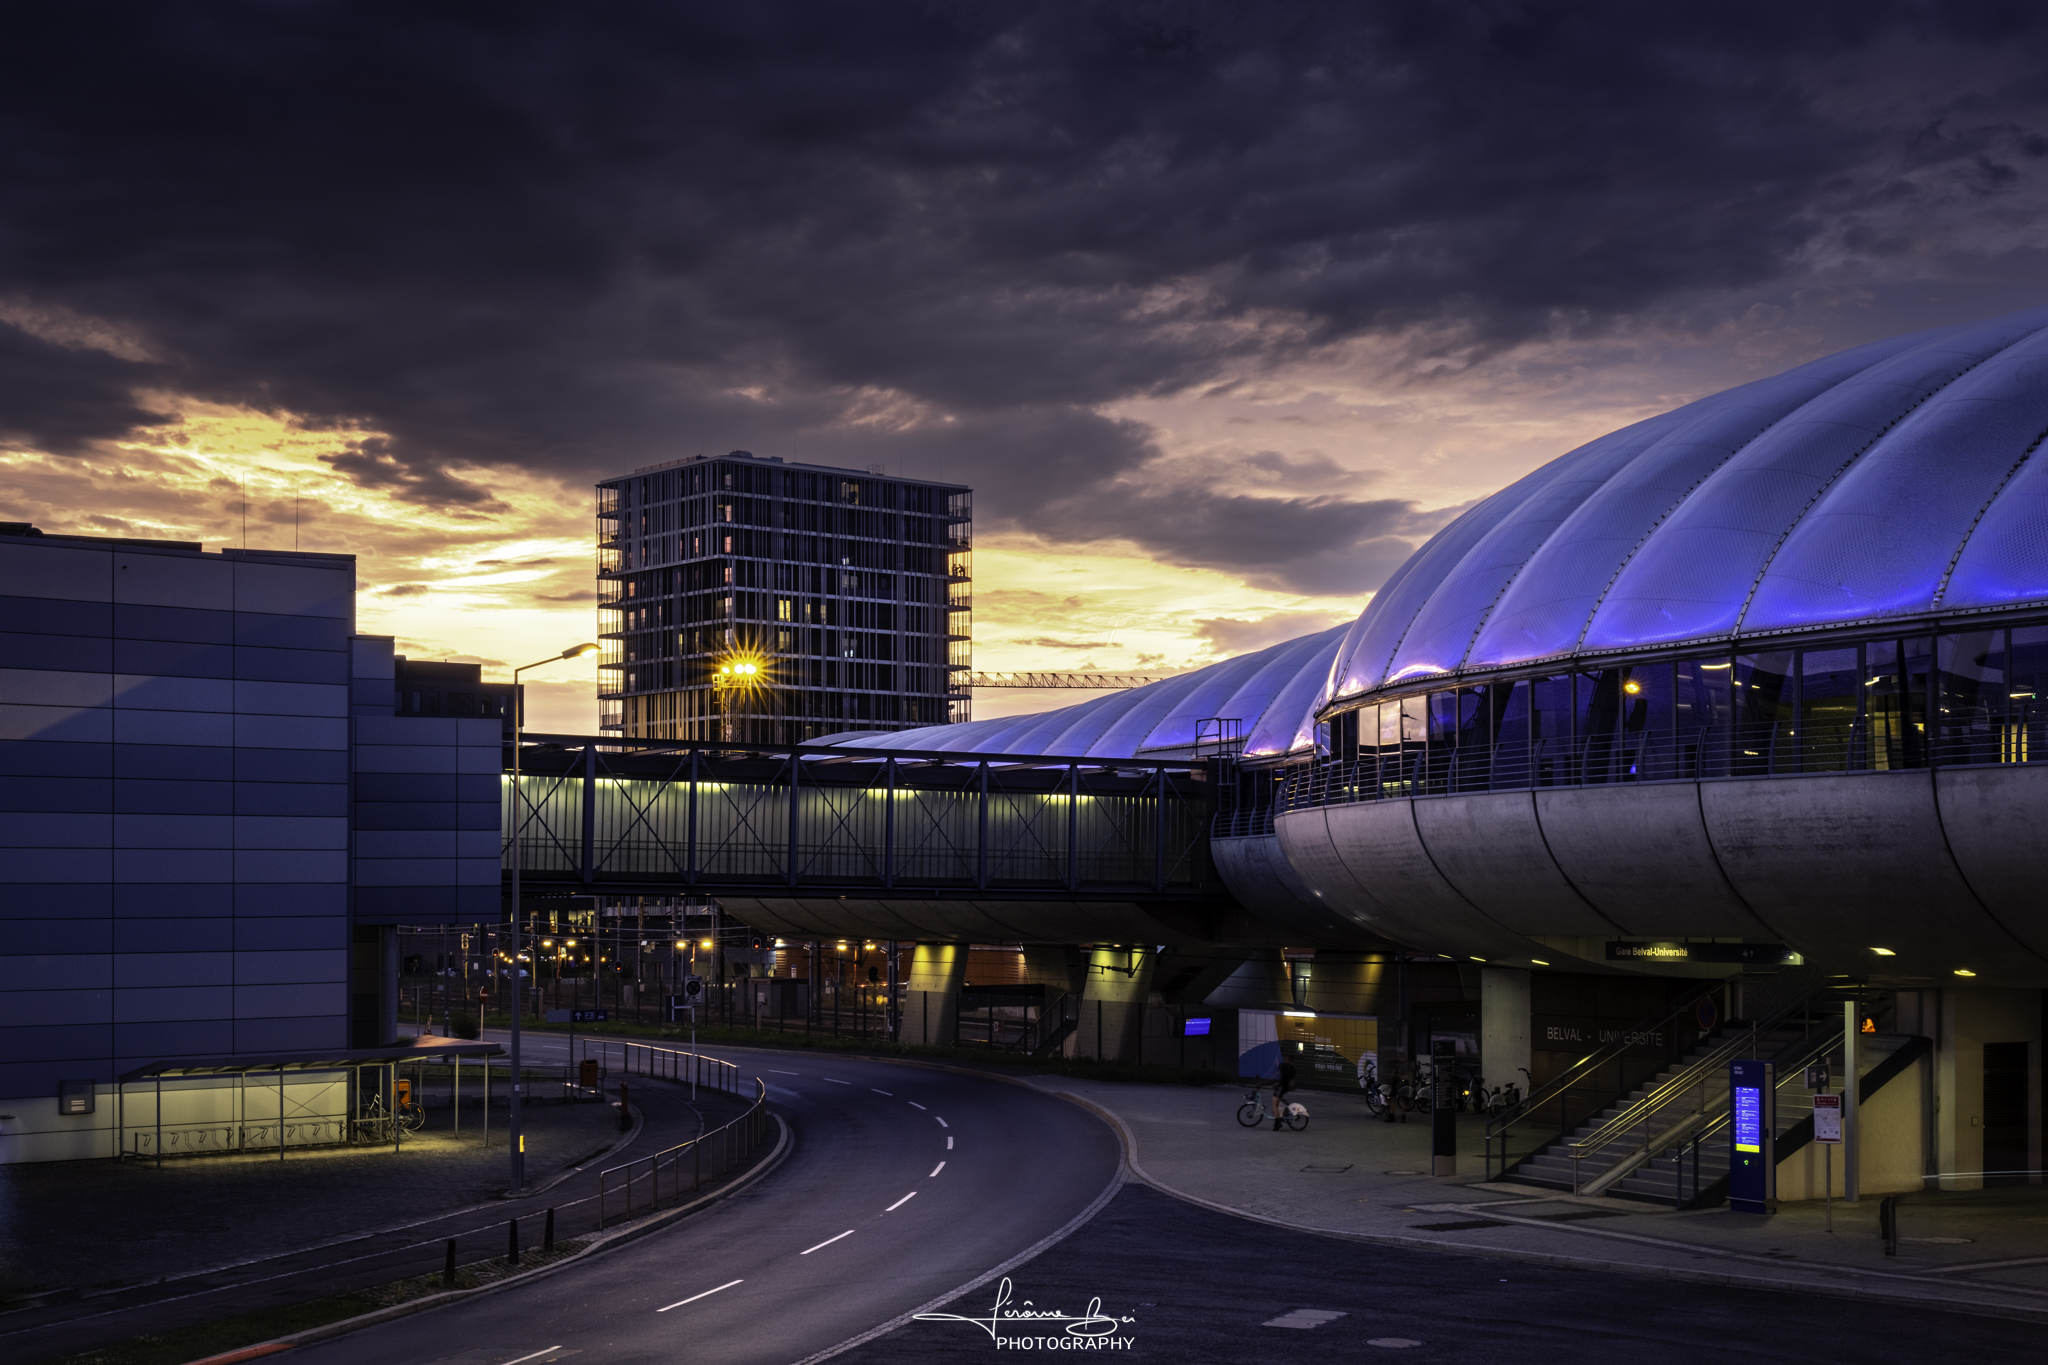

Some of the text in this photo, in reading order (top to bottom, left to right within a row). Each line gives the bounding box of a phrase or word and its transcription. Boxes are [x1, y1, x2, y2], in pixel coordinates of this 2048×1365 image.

[1615, 946, 1688, 957] Gare Belval-Université
[1546, 1026, 1582, 1042] BELVAL
